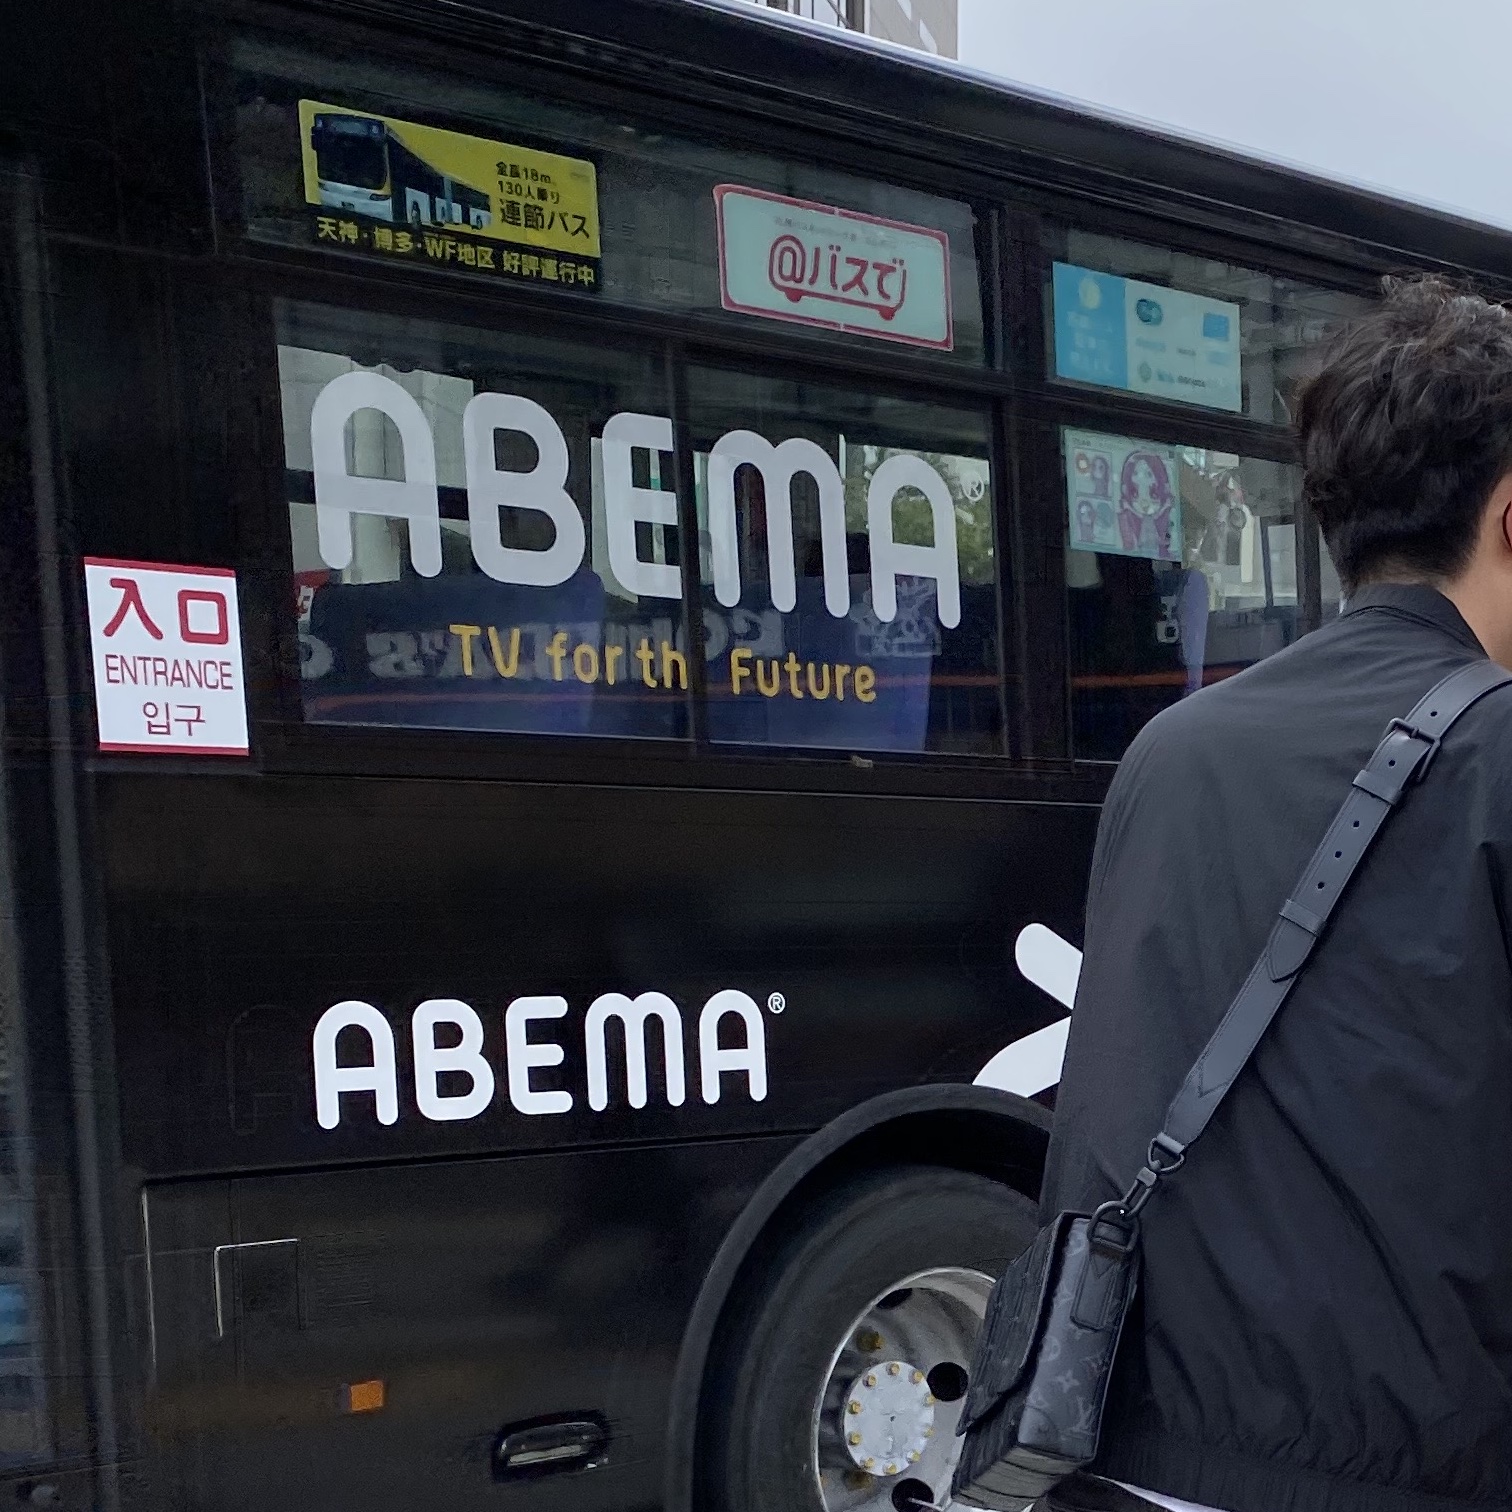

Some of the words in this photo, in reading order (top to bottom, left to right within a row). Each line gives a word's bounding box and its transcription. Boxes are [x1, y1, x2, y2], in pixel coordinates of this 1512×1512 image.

[499, 198, 591, 239] 連節バス
[502, 249, 596, 286] 好評運行中
[103, 577, 229, 645] 入口
[105, 653, 233, 690] ENTRANCE
[449, 624, 521, 679] TV
[544, 631, 622, 686] for
[730, 647, 877, 703] Future
[143, 701, 205, 737] 입구
